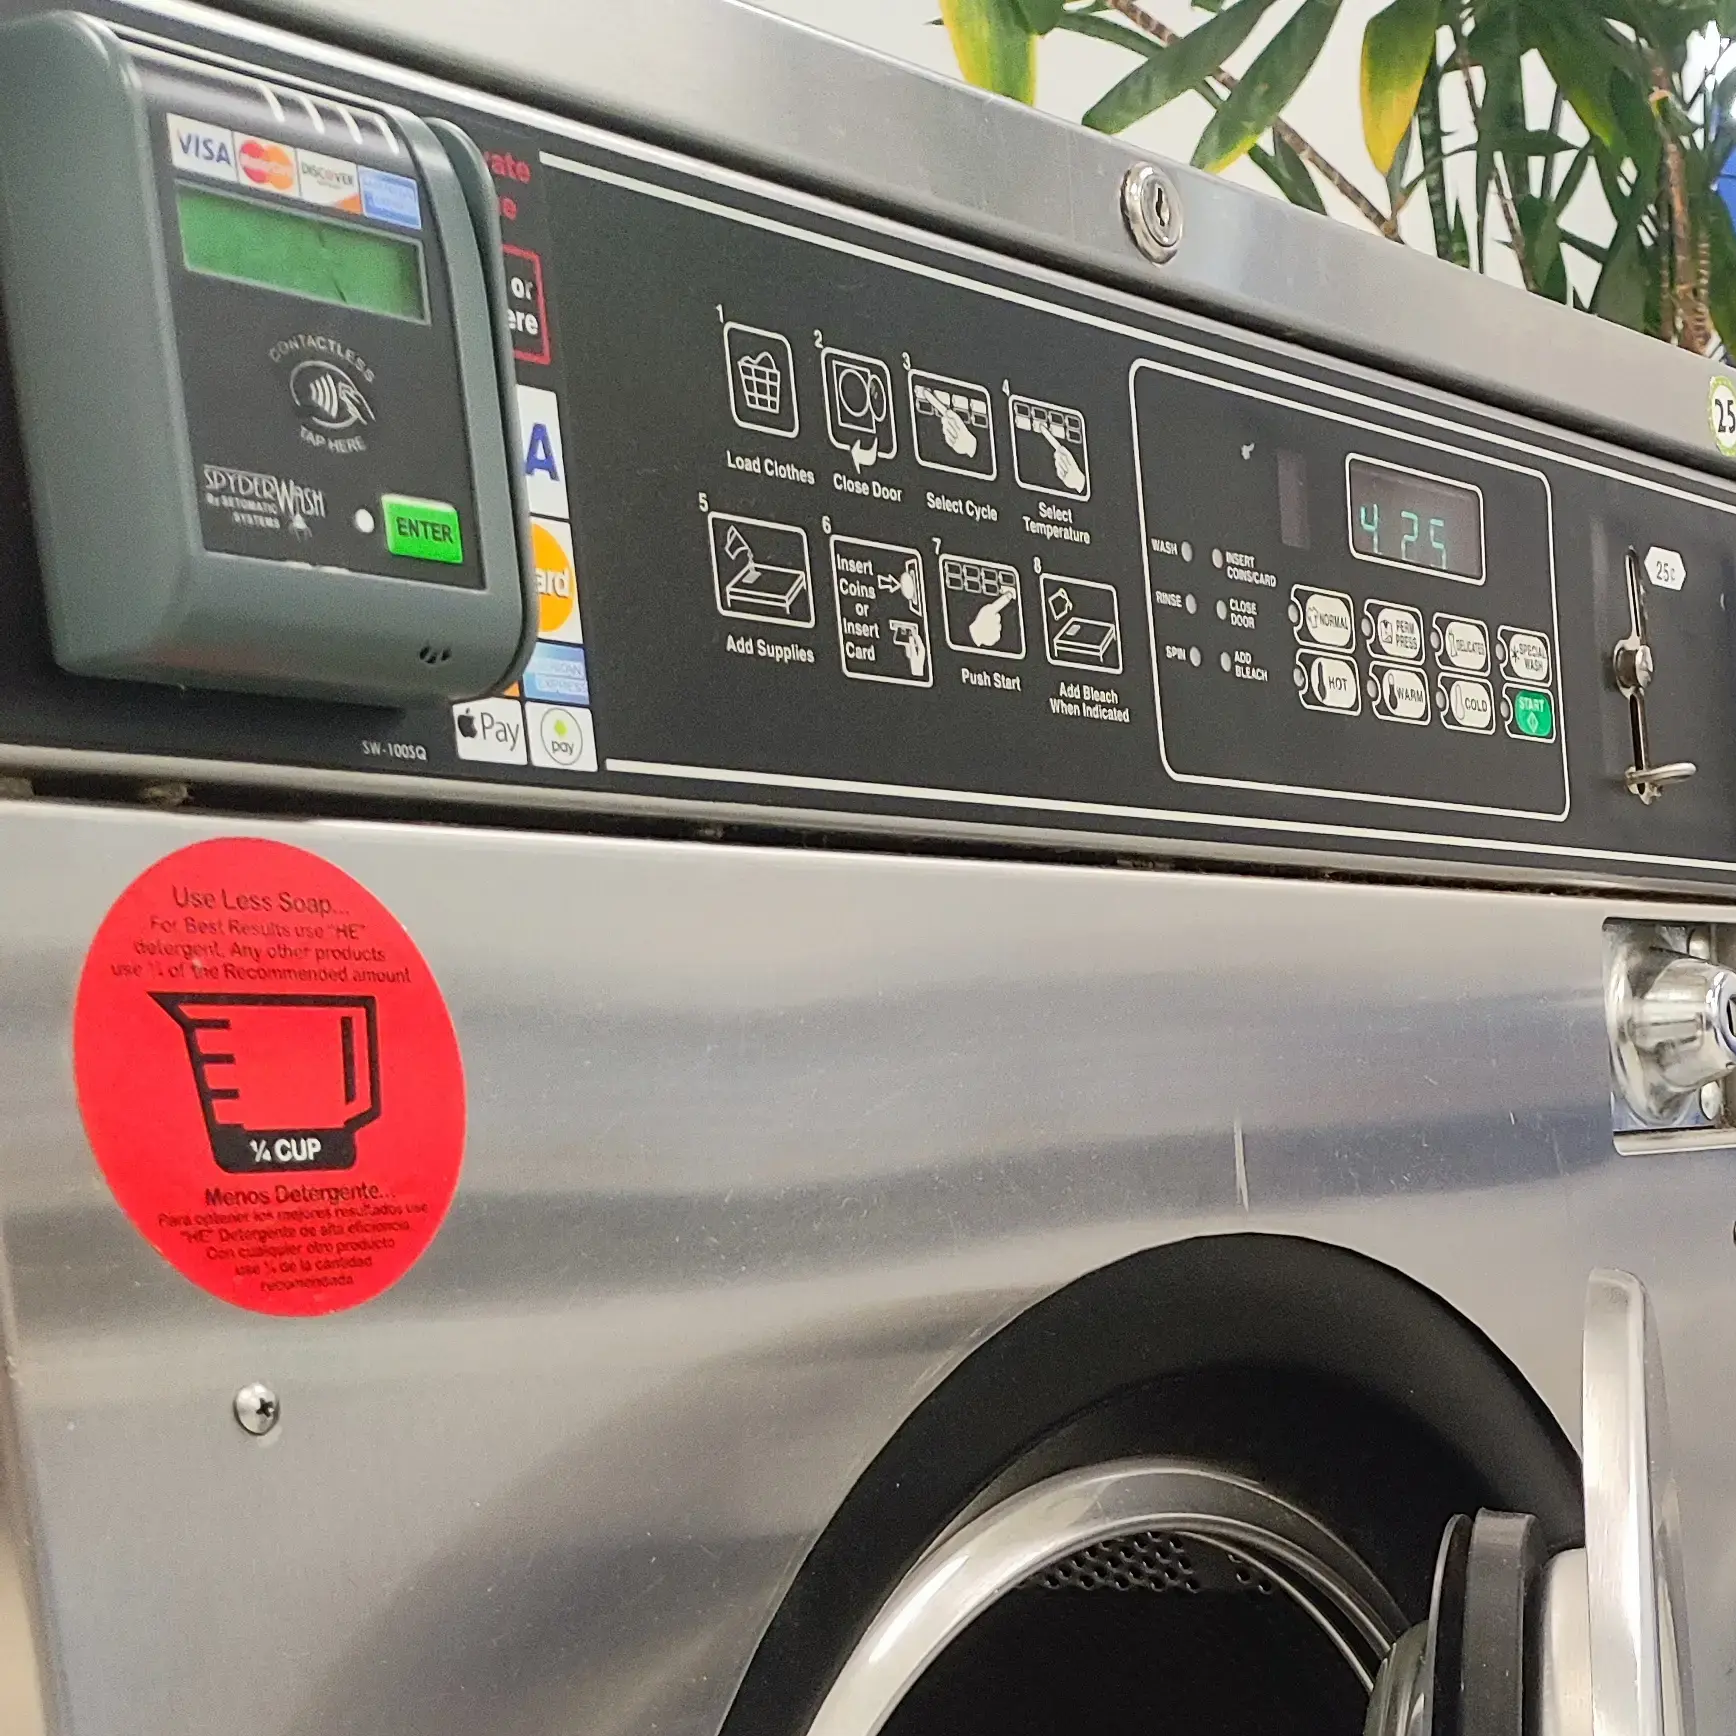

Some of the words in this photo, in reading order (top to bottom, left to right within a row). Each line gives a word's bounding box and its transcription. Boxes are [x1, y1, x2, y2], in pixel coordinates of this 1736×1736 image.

[178, 129, 232, 168] VISA
[510, 276, 534, 300] or
[716, 303, 725, 323] 1
[813, 328, 824, 349] 2
[268, 334, 375, 384] CONTACTLESS
[902, 352, 912, 371] 3
[1002, 378, 1010, 396] 4
[1714, 398, 1736, 433] 25
[300, 425, 327, 447] TAP
[726, 450, 762, 473] Load
[764, 459, 816, 485] Clothes
[833, 472, 869, 496] Close
[872, 481, 902, 502] Door
[698, 492, 709, 512] 5
[926, 492, 963, 515] Select
[966, 500, 998, 522] Cycle
[1038, 501, 1073, 523] Select
[396, 516, 454, 544] ENTER
[821, 515, 832, 534] 6
[1022, 515, 1091, 545] Temperature
[932, 537, 942, 555] 7
[1151, 538, 1178, 555] WASH
[836, 553, 873, 577] Insert
[1226, 551, 1256, 568] INSERT
[839, 579, 876, 600] Coins
[1155, 591, 1183, 608] RINSE
[855, 602, 870, 617] or
[1229, 598, 1258, 616] CLOSE
[842, 616, 880, 640] Insert
[1231, 613, 1256, 629] DOOR
[1318, 613, 1350, 631] NORMAL
[726, 634, 754, 655] Add
[756, 638, 815, 663] Supplies
[845, 641, 876, 661] Card
[1165, 645, 1187, 661] SPIN
[1234, 650, 1252, 665] ADD
[961, 667, 992, 688] Push
[994, 672, 1022, 692] Start
[1235, 664, 1269, 682] BLEACH
[1328, 675, 1348, 691] HOT
[1059, 681, 1081, 700] Add
[1083, 684, 1119, 704] Bleach
[1396, 686, 1424, 704] WARM
[1049, 697, 1080, 717] When
[1082, 701, 1130, 723] Indicated
[1464, 697, 1489, 713] COLD
[1518, 696, 1546, 713] START
[481, 712, 520, 751] Pay
[172, 884, 217, 910] Use
[221, 888, 273, 912] Less
[149, 915, 177, 934] For
[183, 916, 224, 935] Best
[228, 918, 291, 938] Results
[294, 924, 325, 939] use
[230, 941, 261, 963] Any
[266, 943, 311, 960] other
[314, 945, 387, 963] products
[167, 962, 187, 978] of
[223, 963, 348, 983] Recommended
[352, 967, 412, 984] amount
[274, 1137, 322, 1162] CUP
[205, 1187, 270, 1206] Menos
